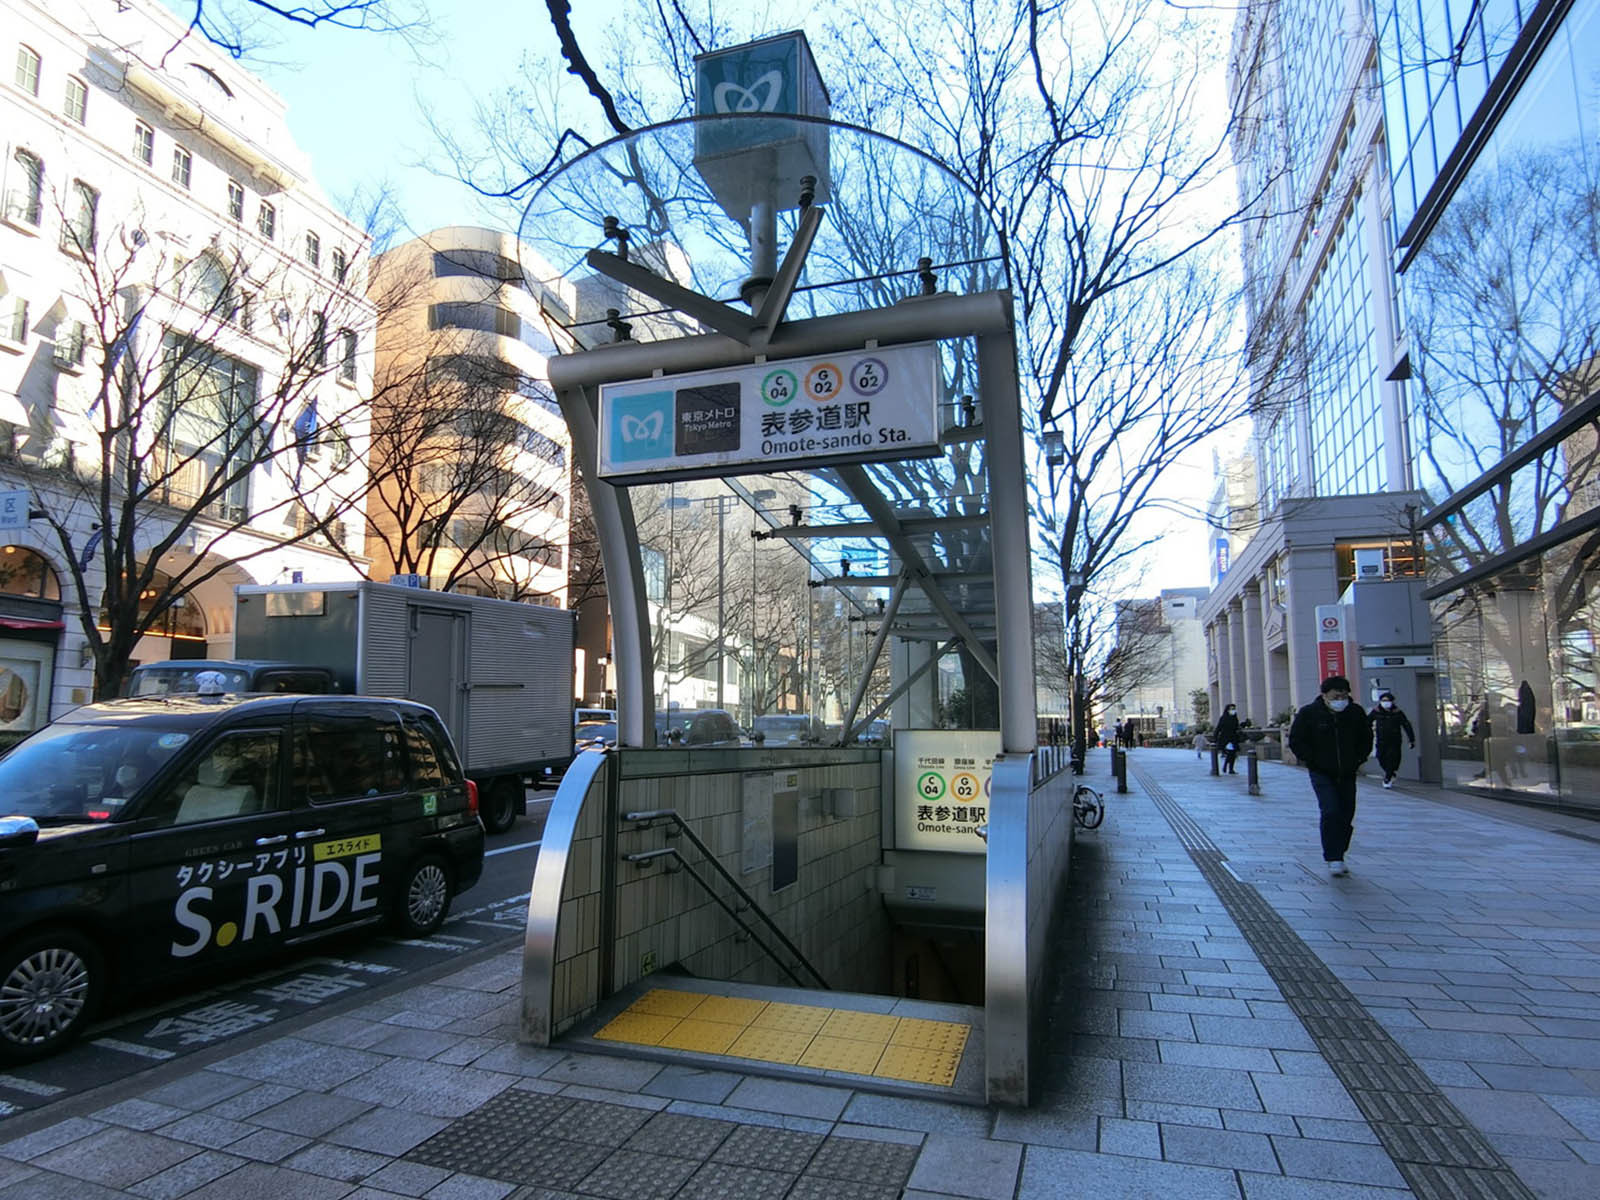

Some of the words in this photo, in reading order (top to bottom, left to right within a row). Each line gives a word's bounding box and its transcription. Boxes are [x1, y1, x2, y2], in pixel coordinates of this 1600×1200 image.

[818, 370, 828, 380] G
[865, 364, 873, 375] Z
[775, 376, 783, 386] C
[860, 376, 878, 388] 02
[770, 388, 788, 399] 04
[814, 382, 832, 394] 02
[681, 407, 735, 423] 東京メトロ
[761, 401, 871, 437] 表参道駅
[685, 423, 707, 432] Tokyo
[708, 421, 732, 429] Metro
[761, 430, 872, 455] Omote-sando
[878, 428, 912, 444] Sta.
[928, 776, 935, 785] C
[960, 777, 969, 786] G
[924, 785, 939, 795] 04
[957, 786, 972, 796] 02
[917, 805, 986, 823] 表参道駅
[326, 840, 370, 856] エスライド
[176, 846, 306, 888] タクシーアプリ
